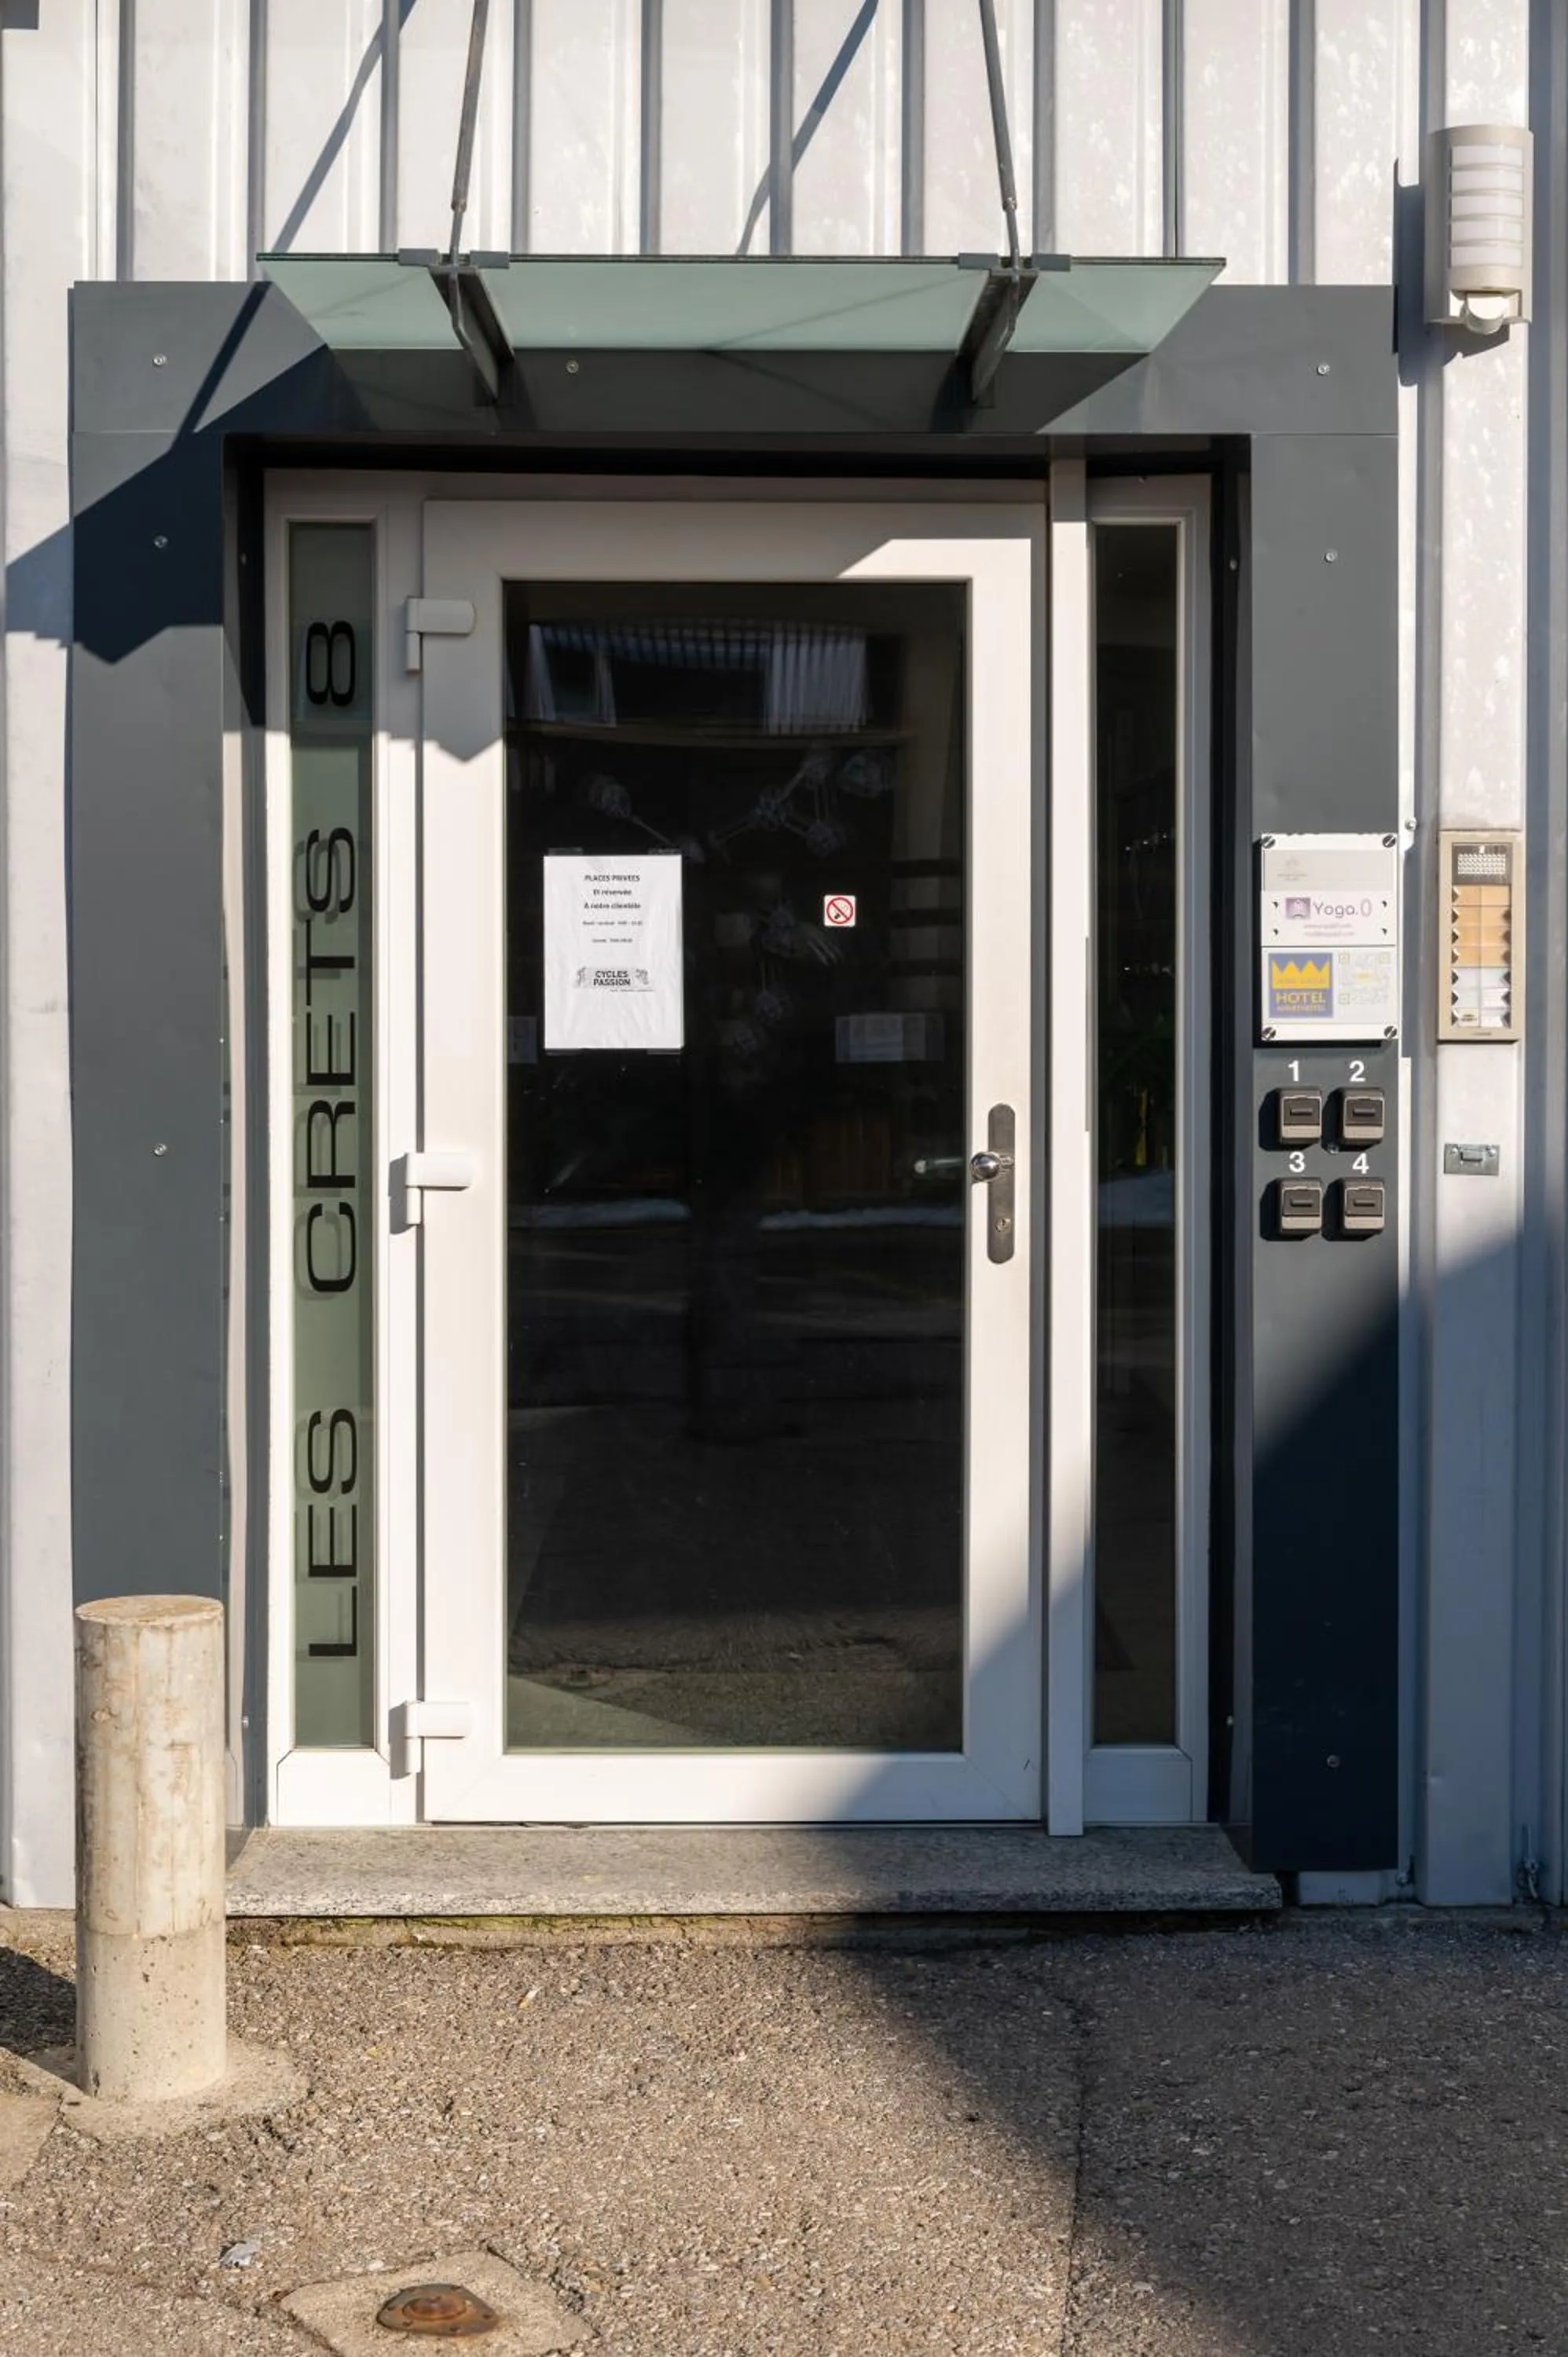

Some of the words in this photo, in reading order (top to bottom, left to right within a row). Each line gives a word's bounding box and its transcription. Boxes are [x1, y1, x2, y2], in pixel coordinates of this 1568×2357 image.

[306, 620, 357, 706] 8
[1276, 992, 1326, 1004] HOTEL
[305, 827, 357, 1292] CRETS
[1288, 1060, 1299, 1082] 1
[1349, 1060, 1366, 1083] 2
[1288, 1151, 1306, 1173] 3
[1352, 1152, 1370, 1175] 4
[307, 1408, 357, 1657] LES
